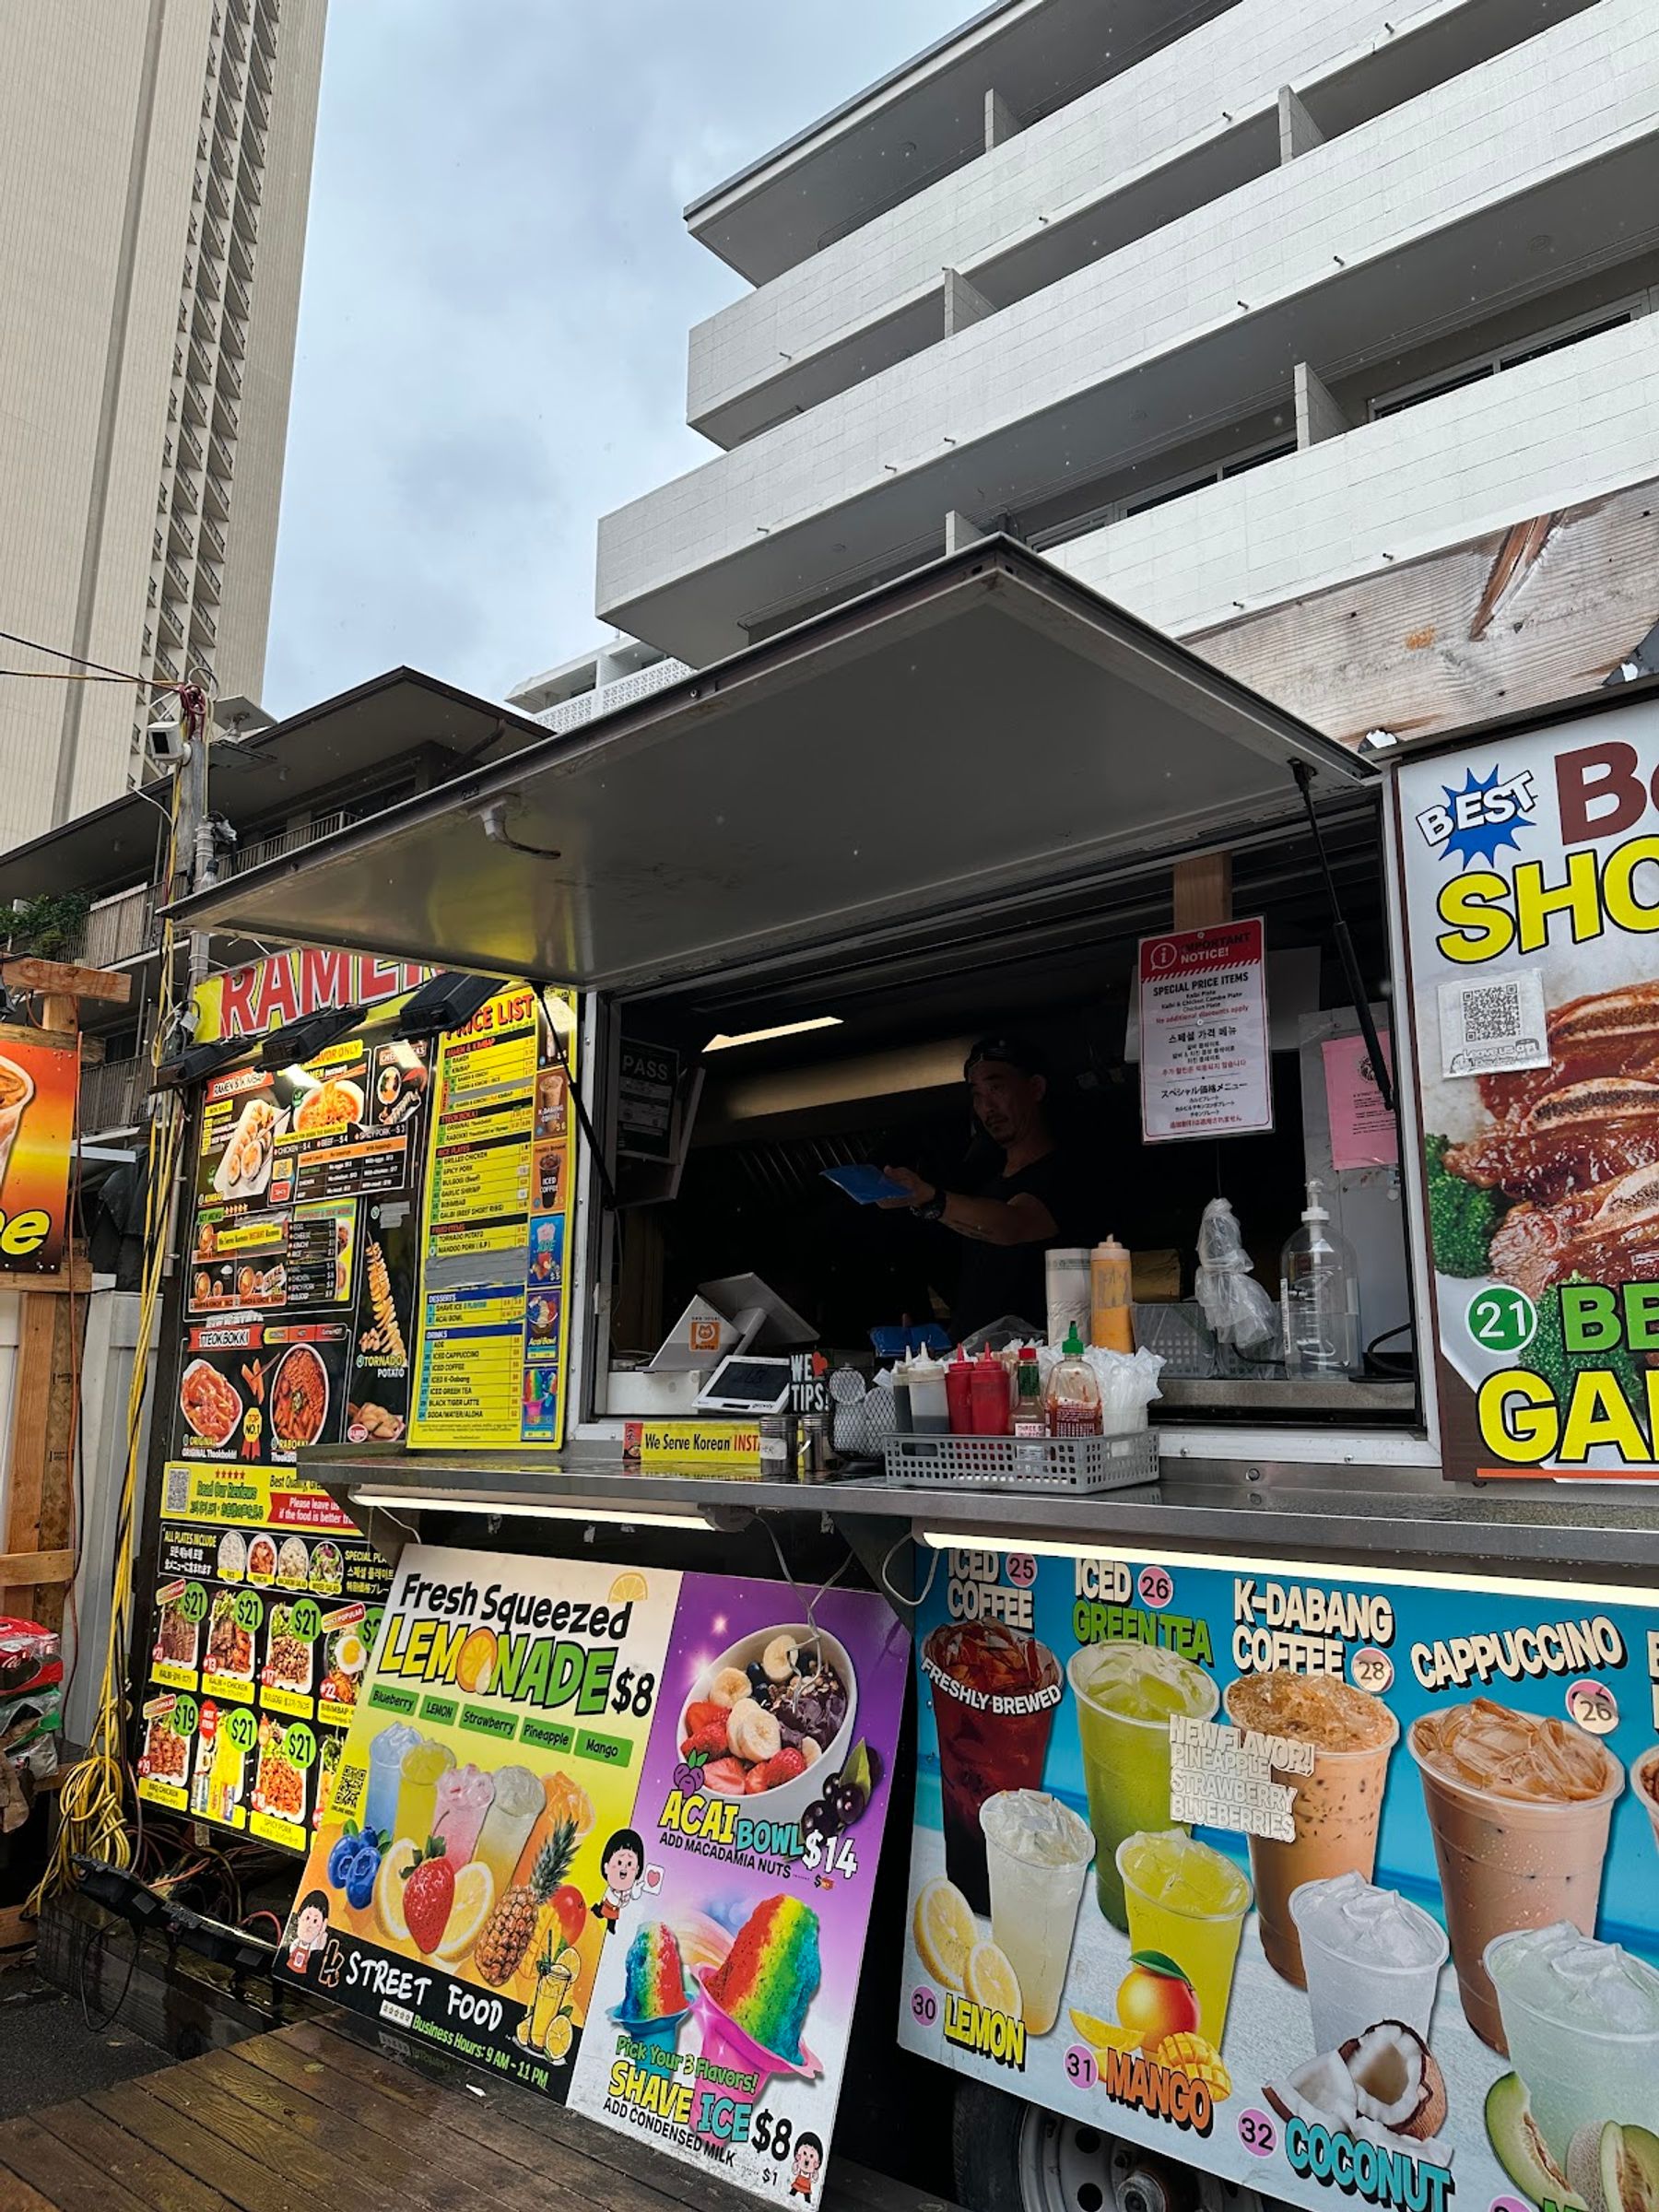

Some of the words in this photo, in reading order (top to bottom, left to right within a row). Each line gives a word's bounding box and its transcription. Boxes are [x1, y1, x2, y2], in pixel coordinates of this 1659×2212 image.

[1554, 741, 1659, 845] B
[1416, 770, 1539, 846] BEST
[1181, 932, 1251, 953] IMPORTANT
[1181, 947, 1229, 964] NOTICE!
[1153, 984, 1189, 996] SPECIAL
[1192, 978, 1218, 990] PRICE
[1221, 972, 1248, 984] ITEMS
[497, 994, 534, 1025] LIST
[1166, 1014, 1196, 1023] additional
[1230, 1005, 1249, 1014] apply
[1198, 1028, 1215, 1039] 가격
[338, 1044, 360, 1058] ONLY
[622, 1054, 669, 1081] PASS
[214, 1082, 233, 1093] RAMEN
[277, 1145, 299, 1155] CHICKEN
[320, 1137, 334, 1147] BEEF
[465, 1152, 488, 1160] CHICKEN
[459, 1164, 473, 1172] PORK
[542, 1177, 557, 1185] ICED
[441, 1189, 460, 1197] GARLIC
[439, 1233, 461, 1241] TORNADO
[462, 1230, 484, 1240] POTATO
[429, 1294, 456, 1303] DESSERTS
[435, 1314, 447, 1323] ACAI
[1476, 1300, 1528, 1338] 21
[1557, 1279, 1659, 1355] BE
[364, 1355, 403, 1366] TORNADO
[445, 1350, 479, 1359] CAPPUCCINO
[791, 1353, 812, 1382] WE
[377, 1368, 405, 1378] POTATO
[791, 1383, 829, 1412] TIPS!
[247, 1414, 259, 1422] TOP
[1476, 1366, 1659, 1465] GA
[189, 1436, 217, 1447] ORIGINAL
[245, 1425, 261, 1434] NO.1
[645, 1433, 661, 1450] We
[664, 1434, 690, 1451] Serve
[693, 1435, 730, 1451] Korean
[733, 1436, 759, 1452] INST
[196, 1480, 214, 1497] Read
[215, 1482, 227, 1498] Our
[228, 1482, 257, 1500] Reviews
[270, 1475, 284, 1487] Best
[278, 1508, 284, 1519] if
[285, 1509, 295, 1519] the
[297, 1509, 312, 1521] food
[313, 1512, 318, 1521] is
[320, 1512, 341, 1523] better
[289, 1497, 311, 1509] Please
[312, 1498, 329, 1510] leave
[164, 1531, 173, 1542] ALL
[174, 1532, 193, 1545] PLATES
[193, 1534, 217, 1547] INCLUDE
[345, 1550, 371, 1561] SPECIAL
[947, 1549, 1000, 1584] ICED
[1007, 1554, 1034, 1580] 25
[1074, 1558, 1133, 1605] ICED
[1140, 1574, 1170, 1600] 26
[185, 1591, 205, 1617] $21
[237, 1598, 259, 1625] $21
[400, 1572, 480, 1617] Fresh
[481, 1584, 633, 1641] Squeezed
[947, 1580, 1034, 1630] COFFEE
[1232, 1578, 1396, 1647] K-DABANG
[294, 1609, 317, 1637] $21
[1072, 1604, 1158, 1648] GREEN
[1158, 1615, 1216, 1667] TEA
[377, 1613, 618, 1716] LEMONADE
[611, 1667, 655, 1718] $8
[1231, 1624, 1346, 1684] COFFEE
[1359, 1660, 1386, 1681] 28
[1409, 1615, 1629, 1693] CAPPUCCINO
[921, 1656, 992, 1712] FRESHLY
[992, 1684, 1063, 1716] BREWED
[372, 1688, 415, 1712] Blueberry
[425, 1700, 453, 1720] LEMON
[1583, 1700, 1613, 1723] 26
[172, 1703, 195, 1733] $19
[230, 1715, 253, 1744] $21
[463, 1710, 515, 1735] Strawberry
[524, 1724, 570, 1746] Pineapple
[1171, 1714, 1216, 1750] NEW
[288, 1732, 312, 1762] $21
[585, 1738, 618, 1758] Mango
[1171, 1744, 1271, 1782] PINEAPPLE
[1171, 1768, 1298, 1814] STRAWBERRY
[265, 1818, 277, 1827] SPICY
[277, 1822, 292, 1833] PORK
[1171, 1793, 1296, 1843] BLUEBERRIES
[656, 1788, 740, 1845] ACAI
[735, 1817, 805, 1855] BOWL
[801, 1828, 859, 1881] $14
[659, 1830, 683, 1848] ADD
[683, 1836, 756, 1871] MACADAMIA
[757, 1856, 792, 1880] NUTS
[346, 1950, 432, 2006] STREET
[447, 1983, 503, 2031] FOOD
[912, 1993, 936, 2020] 30
[944, 1993, 1027, 2073] LEMON
[412, 2014, 453, 2047] Business
[454, 2031, 486, 2059] Hours:
[485, 2046, 493, 2064] 9
[493, 2049, 510, 2071] AM
[517, 2060, 529, 2080] 11
[530, 2065, 549, 2088] PM
[615, 2034, 647, 2062] Pick
[647, 2042, 683, 2076] Your
[683, 2053, 695, 2075] 3
[695, 2058, 759, 2093] Flavors!
[1066, 2052, 1093, 2082] 31
[1106, 2046, 1214, 2138] MANGO
[607, 2061, 694, 2125] SHAVE
[700, 2092, 754, 2144] ICE
[750, 2108, 793, 2161] $8
[603, 2096, 630, 2120] ADD
[629, 2106, 703, 2155] CONDENSED
[703, 2141, 736, 2169] MILK
[762, 2165, 779, 2187] $1
[1240, 2117, 1274, 2151] 32
[1285, 2116, 1456, 2212] COCONUT
